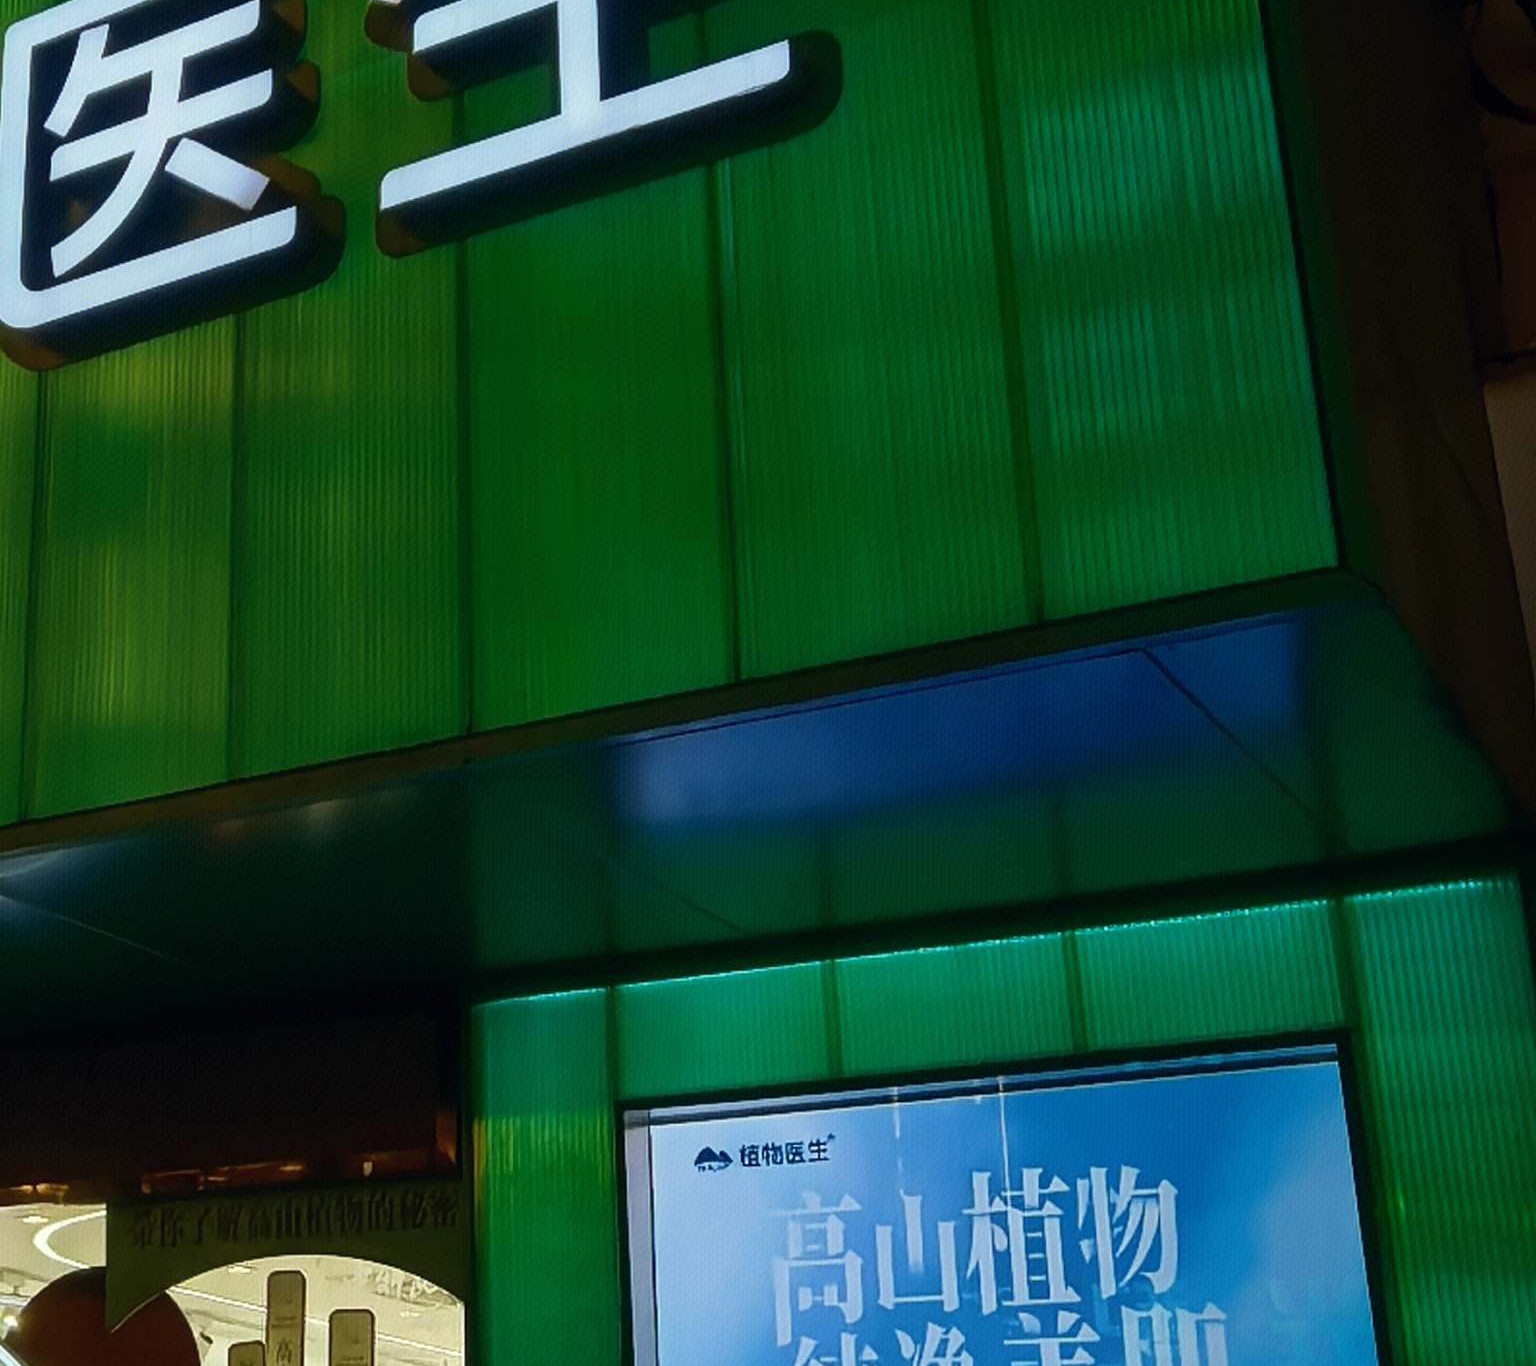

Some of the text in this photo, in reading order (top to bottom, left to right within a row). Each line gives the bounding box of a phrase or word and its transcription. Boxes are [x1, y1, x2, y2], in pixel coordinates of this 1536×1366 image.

[739, 1138, 830, 1167] 植物医生
[769, 1165, 1178, 1347] 高山植物
